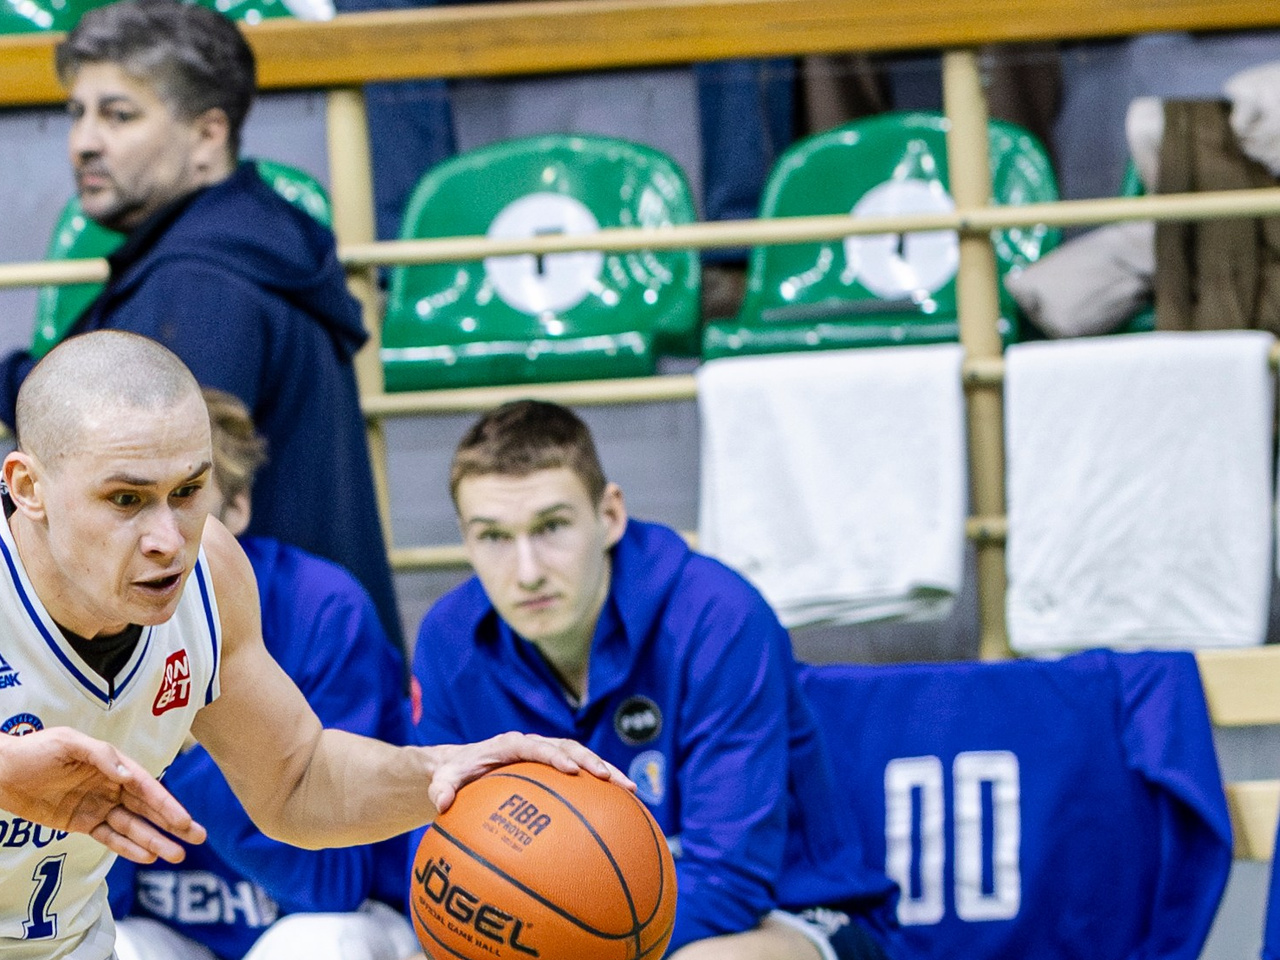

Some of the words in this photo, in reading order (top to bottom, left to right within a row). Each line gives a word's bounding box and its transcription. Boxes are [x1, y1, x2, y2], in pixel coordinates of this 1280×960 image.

[498, 794, 552, 837] FIBA
[884, 749, 1021, 926] 00
[21, 852, 67, 940] 1
[414, 857, 540, 958] JÖGEL
